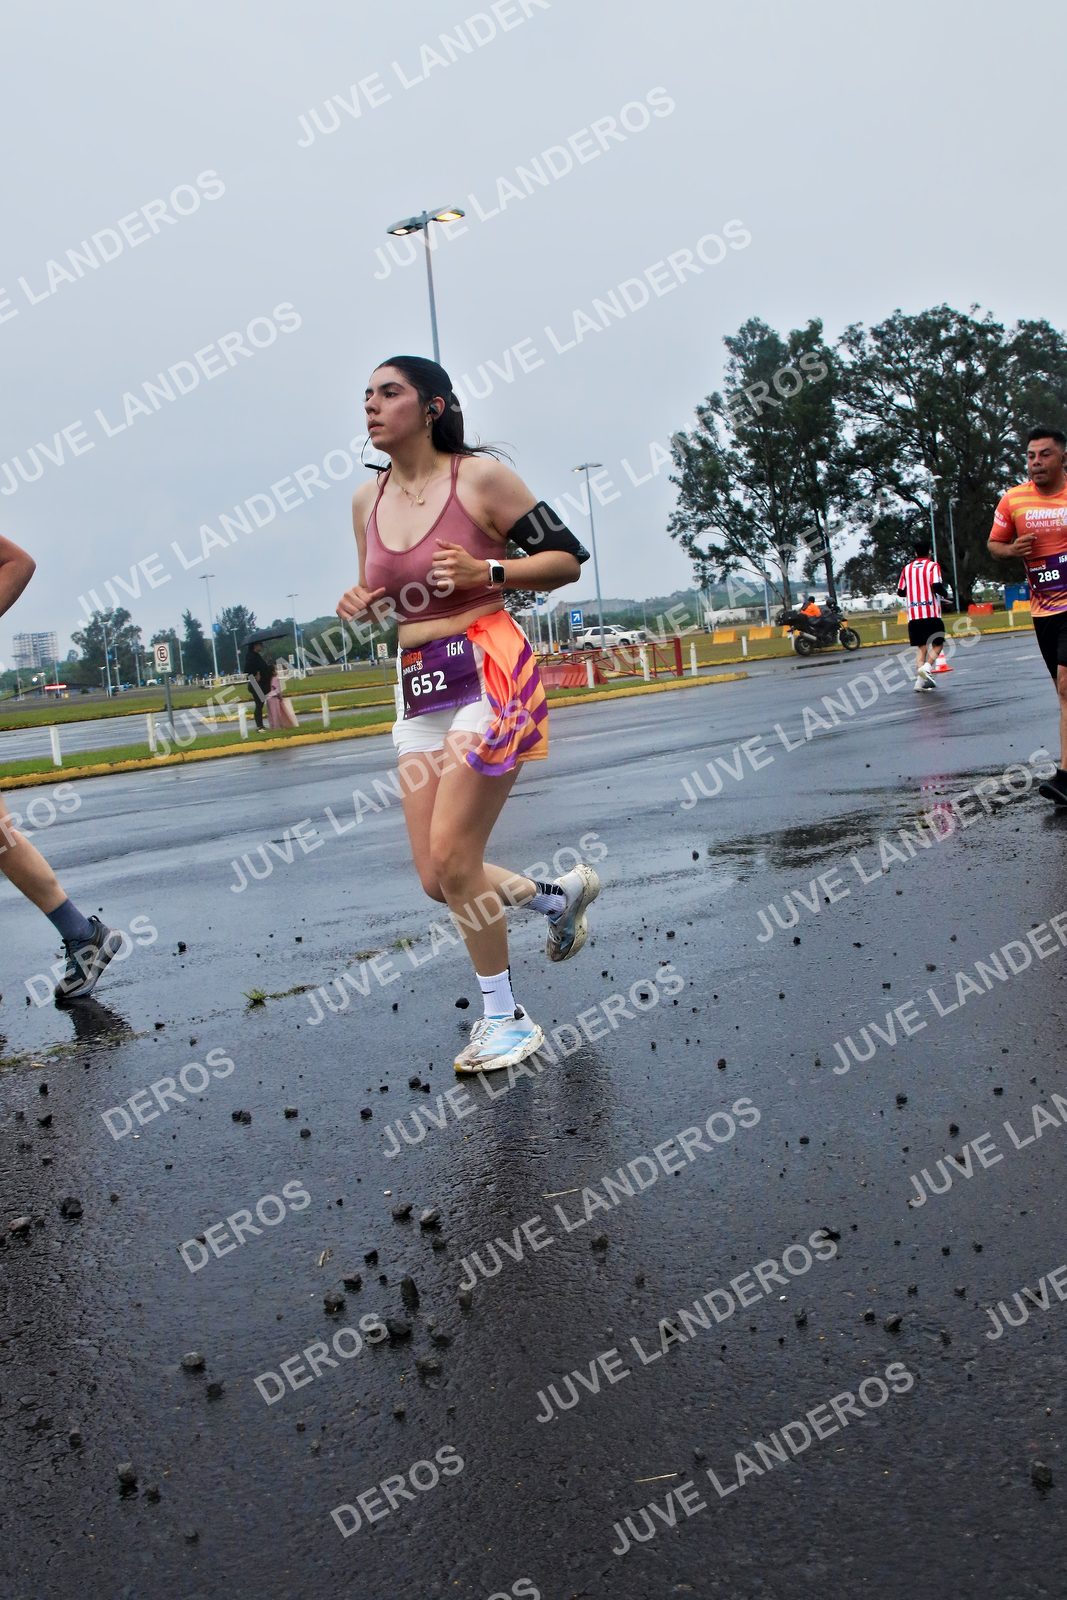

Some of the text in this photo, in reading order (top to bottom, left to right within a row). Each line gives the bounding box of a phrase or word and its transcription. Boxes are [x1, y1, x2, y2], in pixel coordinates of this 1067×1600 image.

[1025, 508, 1067, 521] CARRER
[1038, 570, 1060, 583] 288
[411, 670, 448, 696] 652
